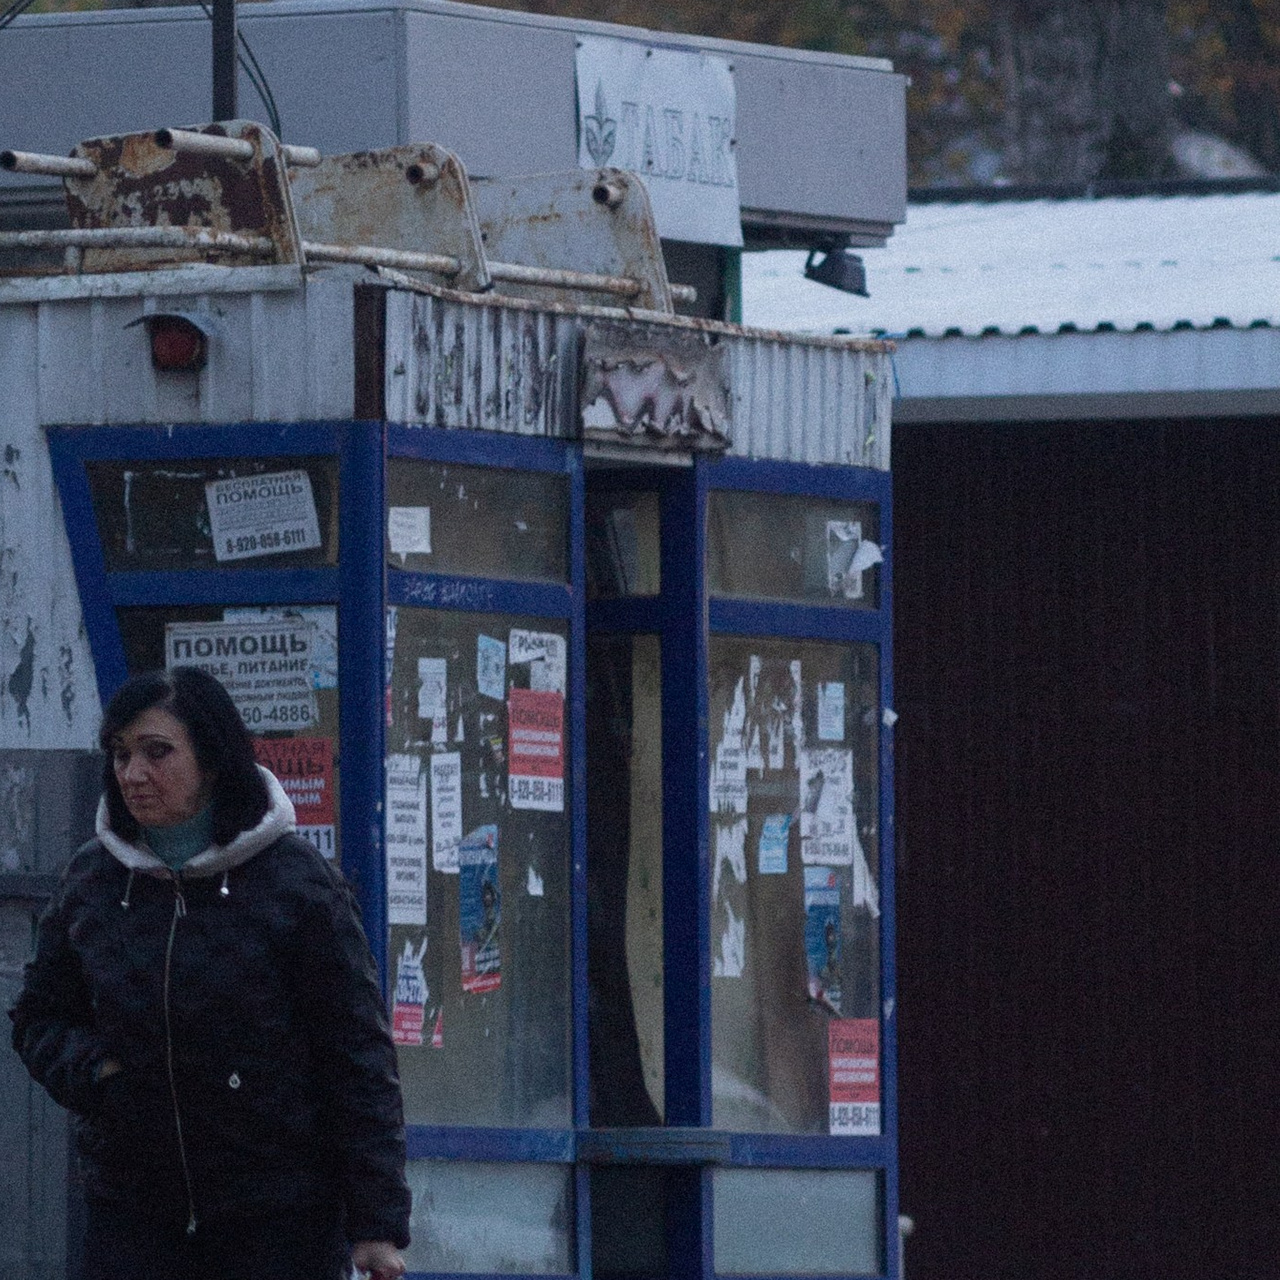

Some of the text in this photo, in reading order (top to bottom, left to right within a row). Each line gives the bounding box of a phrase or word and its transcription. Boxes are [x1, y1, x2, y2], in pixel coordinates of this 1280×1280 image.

[621, 101, 735, 188] ТАБАК
[217, 483, 304, 504] ПОМОЩЬ
[173, 634, 308, 660] ПОМОЩЬ
[238, 659, 308, 675] ПИТАНИЕ
[242, 705, 310, 724] 50-4886
